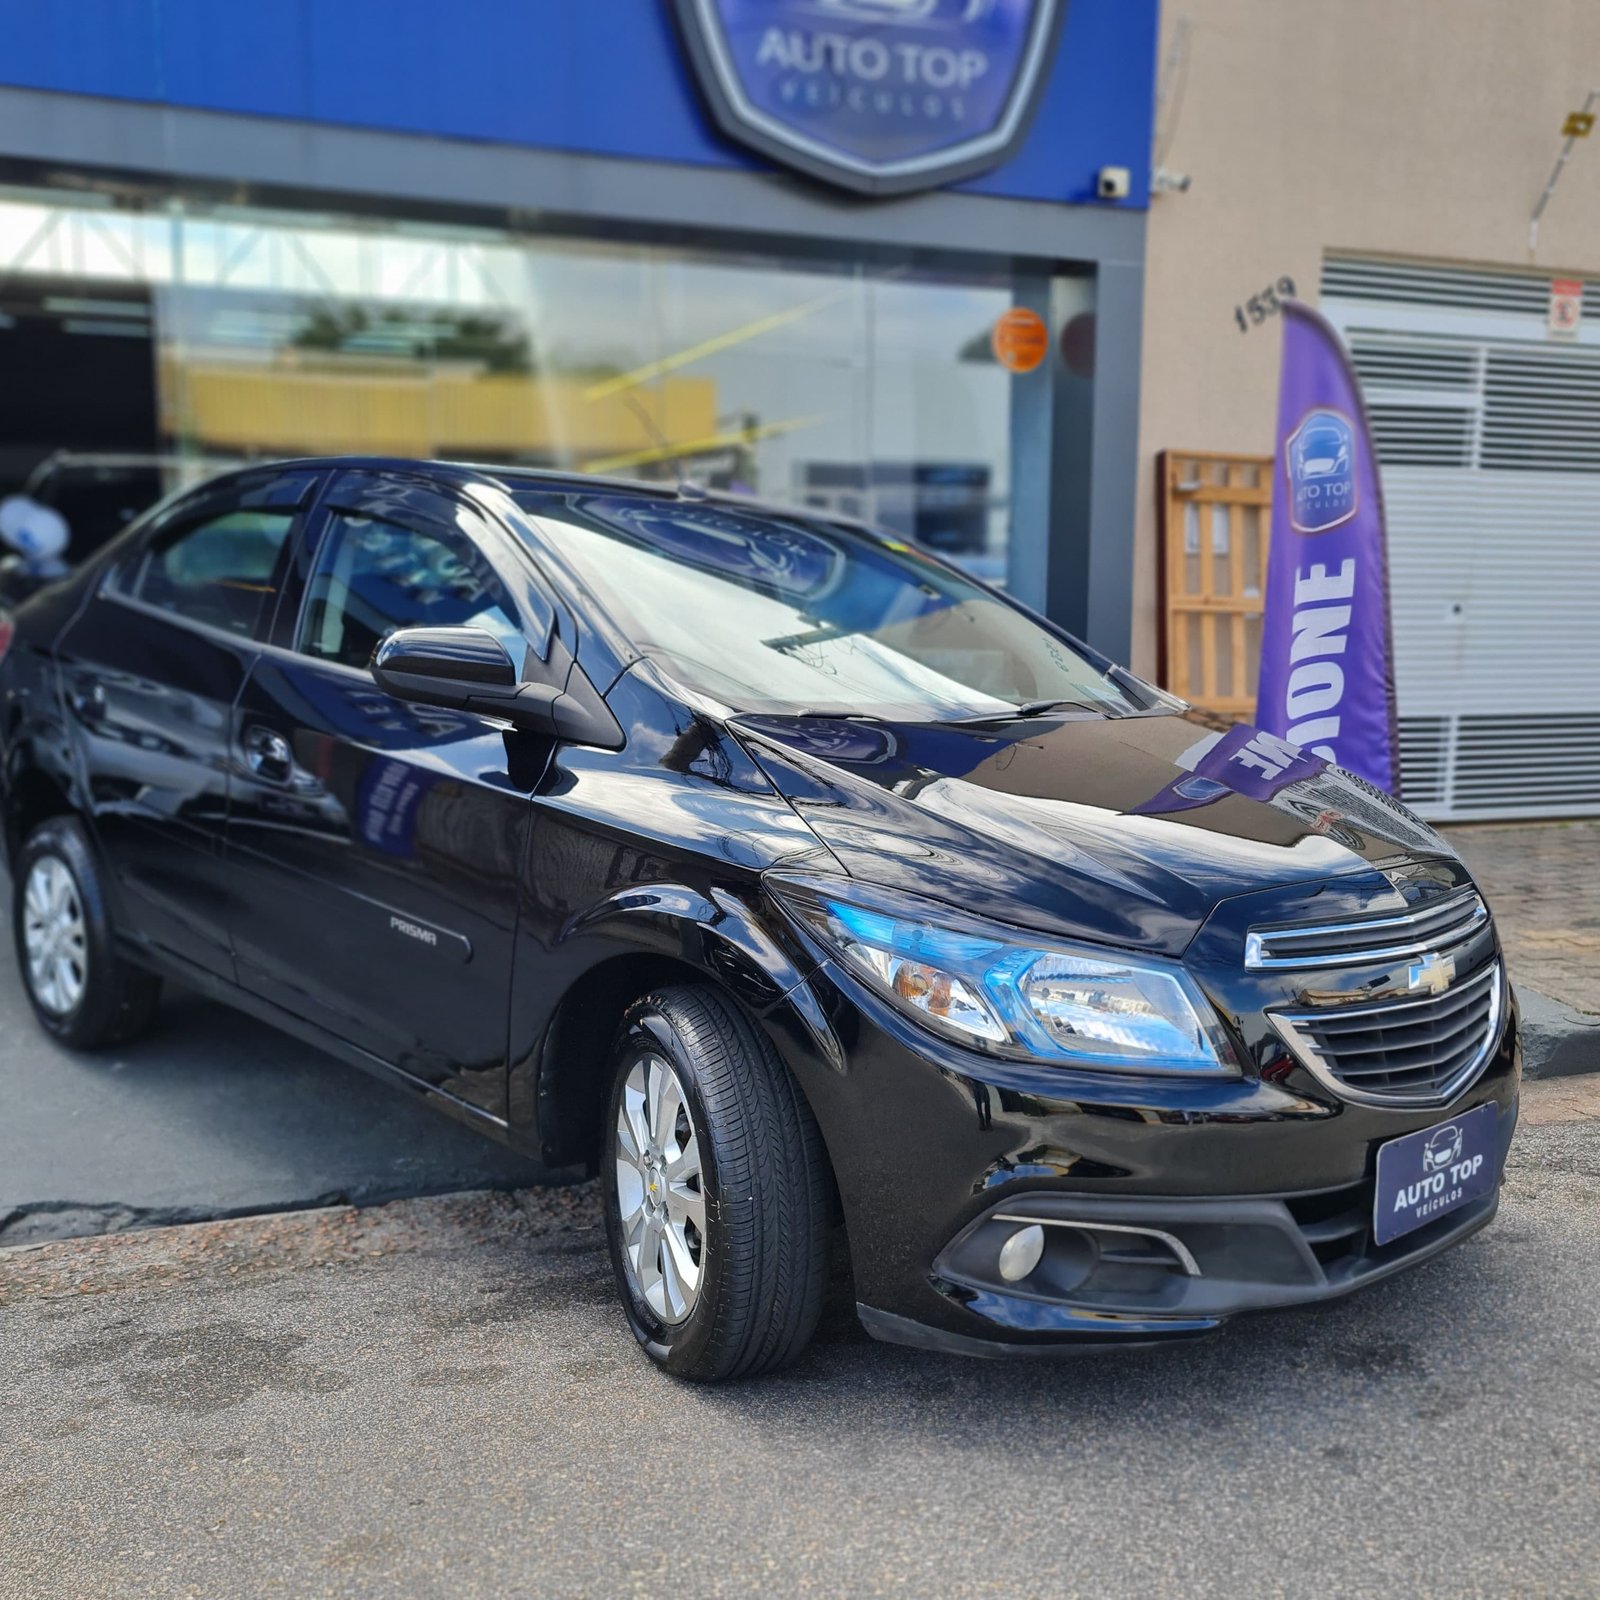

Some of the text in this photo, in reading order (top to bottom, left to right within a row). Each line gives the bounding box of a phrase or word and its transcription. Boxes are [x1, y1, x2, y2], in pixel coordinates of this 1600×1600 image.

[757, 26, 988, 91] AUTO TOP
[1323, 481, 1351, 497] TOP
[391, 916, 437, 946] PRISMA
[1394, 1154, 1483, 1213] AUTO TOP
